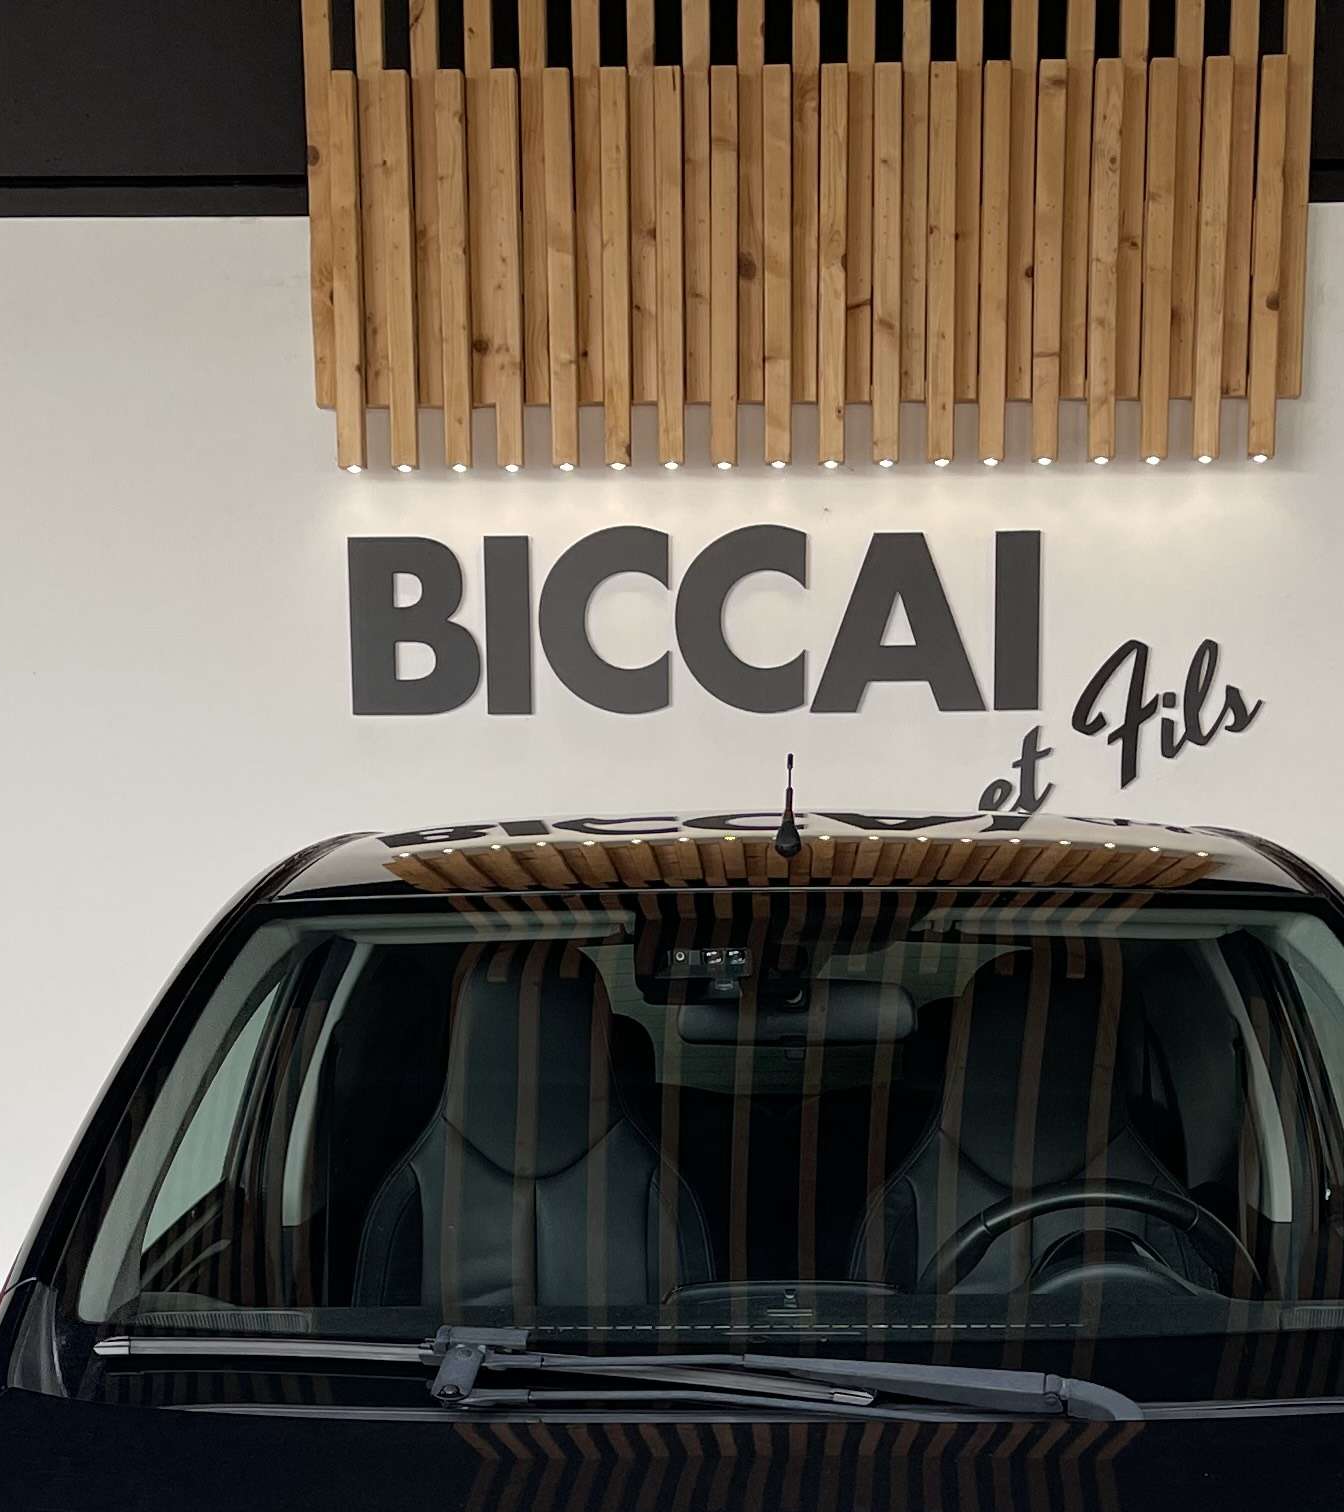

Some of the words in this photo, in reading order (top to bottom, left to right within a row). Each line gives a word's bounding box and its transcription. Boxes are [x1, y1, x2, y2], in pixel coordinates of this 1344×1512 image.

[347, 524, 1041, 715] BICCAI
[977, 724, 1053, 814] et
[1071, 638, 1261, 790] Fils
